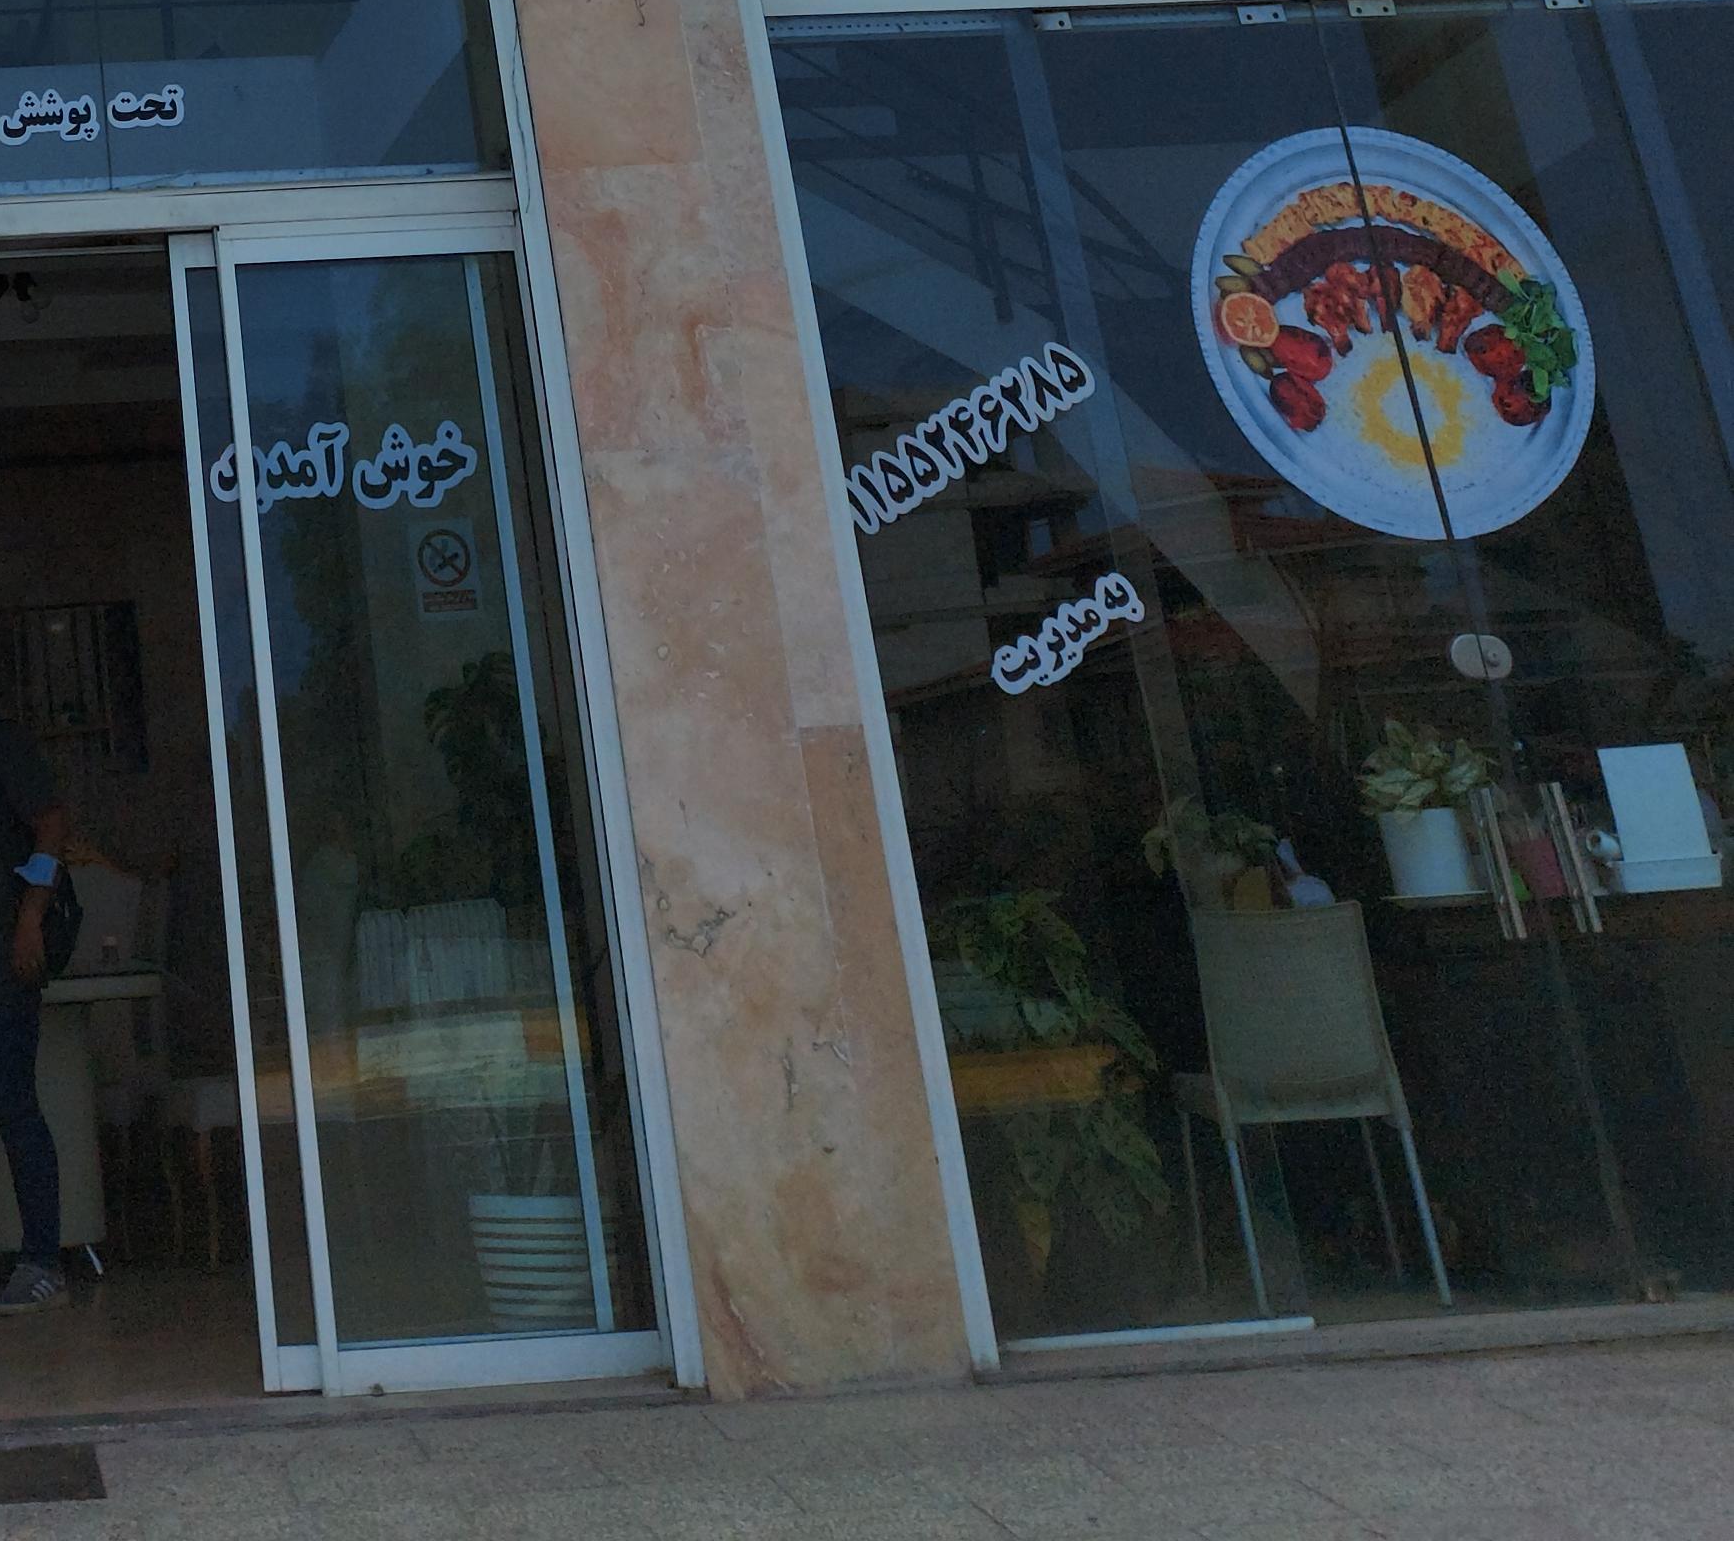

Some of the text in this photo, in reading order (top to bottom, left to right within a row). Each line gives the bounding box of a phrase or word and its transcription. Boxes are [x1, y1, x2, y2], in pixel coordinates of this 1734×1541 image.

[3, 92, 92, 139] پوشش
[112, 88, 179, 120] تحت
[360, 429, 468, 499] خوش
[1000, 581, 1137, 683] به مدیریت
